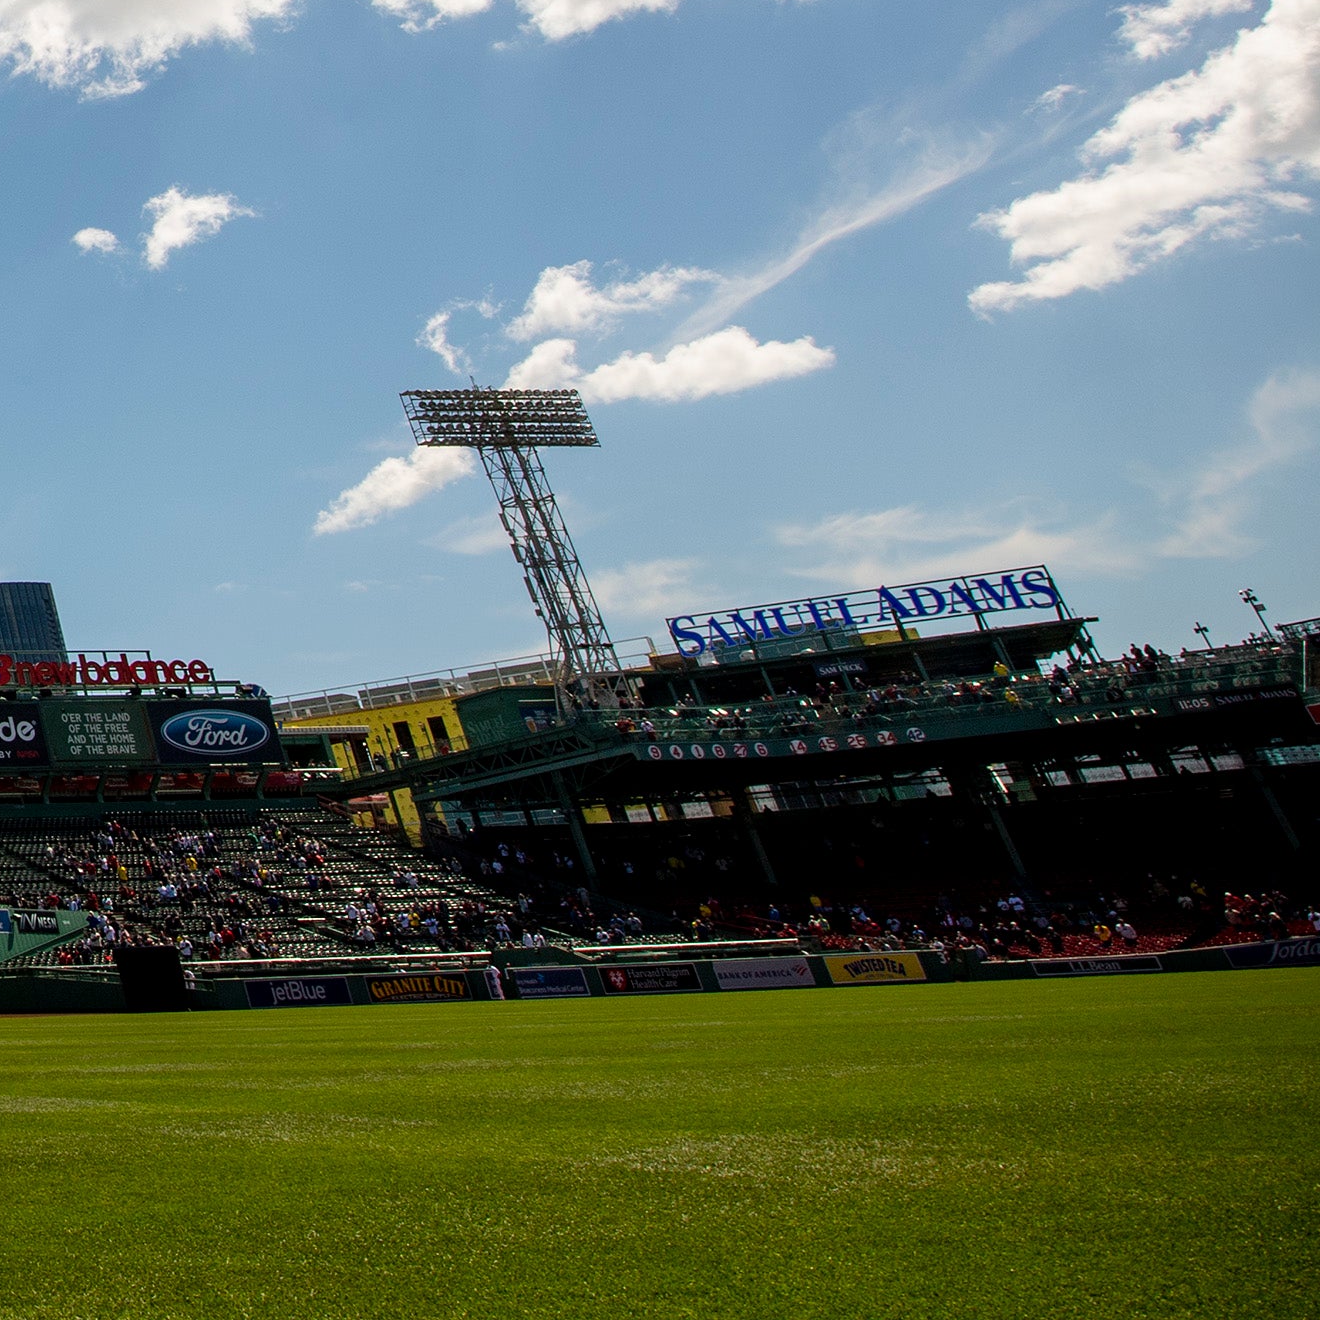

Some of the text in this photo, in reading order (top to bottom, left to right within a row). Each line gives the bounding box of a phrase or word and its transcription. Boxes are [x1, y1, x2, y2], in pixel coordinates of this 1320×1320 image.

[670, 570, 1059, 658] SAMUEL ADAMS
[1178, 697, 1209, 710] 11:05
[61, 712, 130, 722] O'ER THE LAND
[68, 723, 129, 733] OF THE FREE
[185, 716, 248, 746] Ford
[68, 733, 136, 744] AND THE HOME
[70, 744, 137, 755] OF THE BRAVE
[37, 916, 57, 928] NESN
[843, 957, 907, 978] TWISTED TEA
[717, 969, 792, 980] BANK OF AMERICA
[270, 980, 326, 1005] jetBlue
[371, 975, 465, 999] GRANITE CITY
